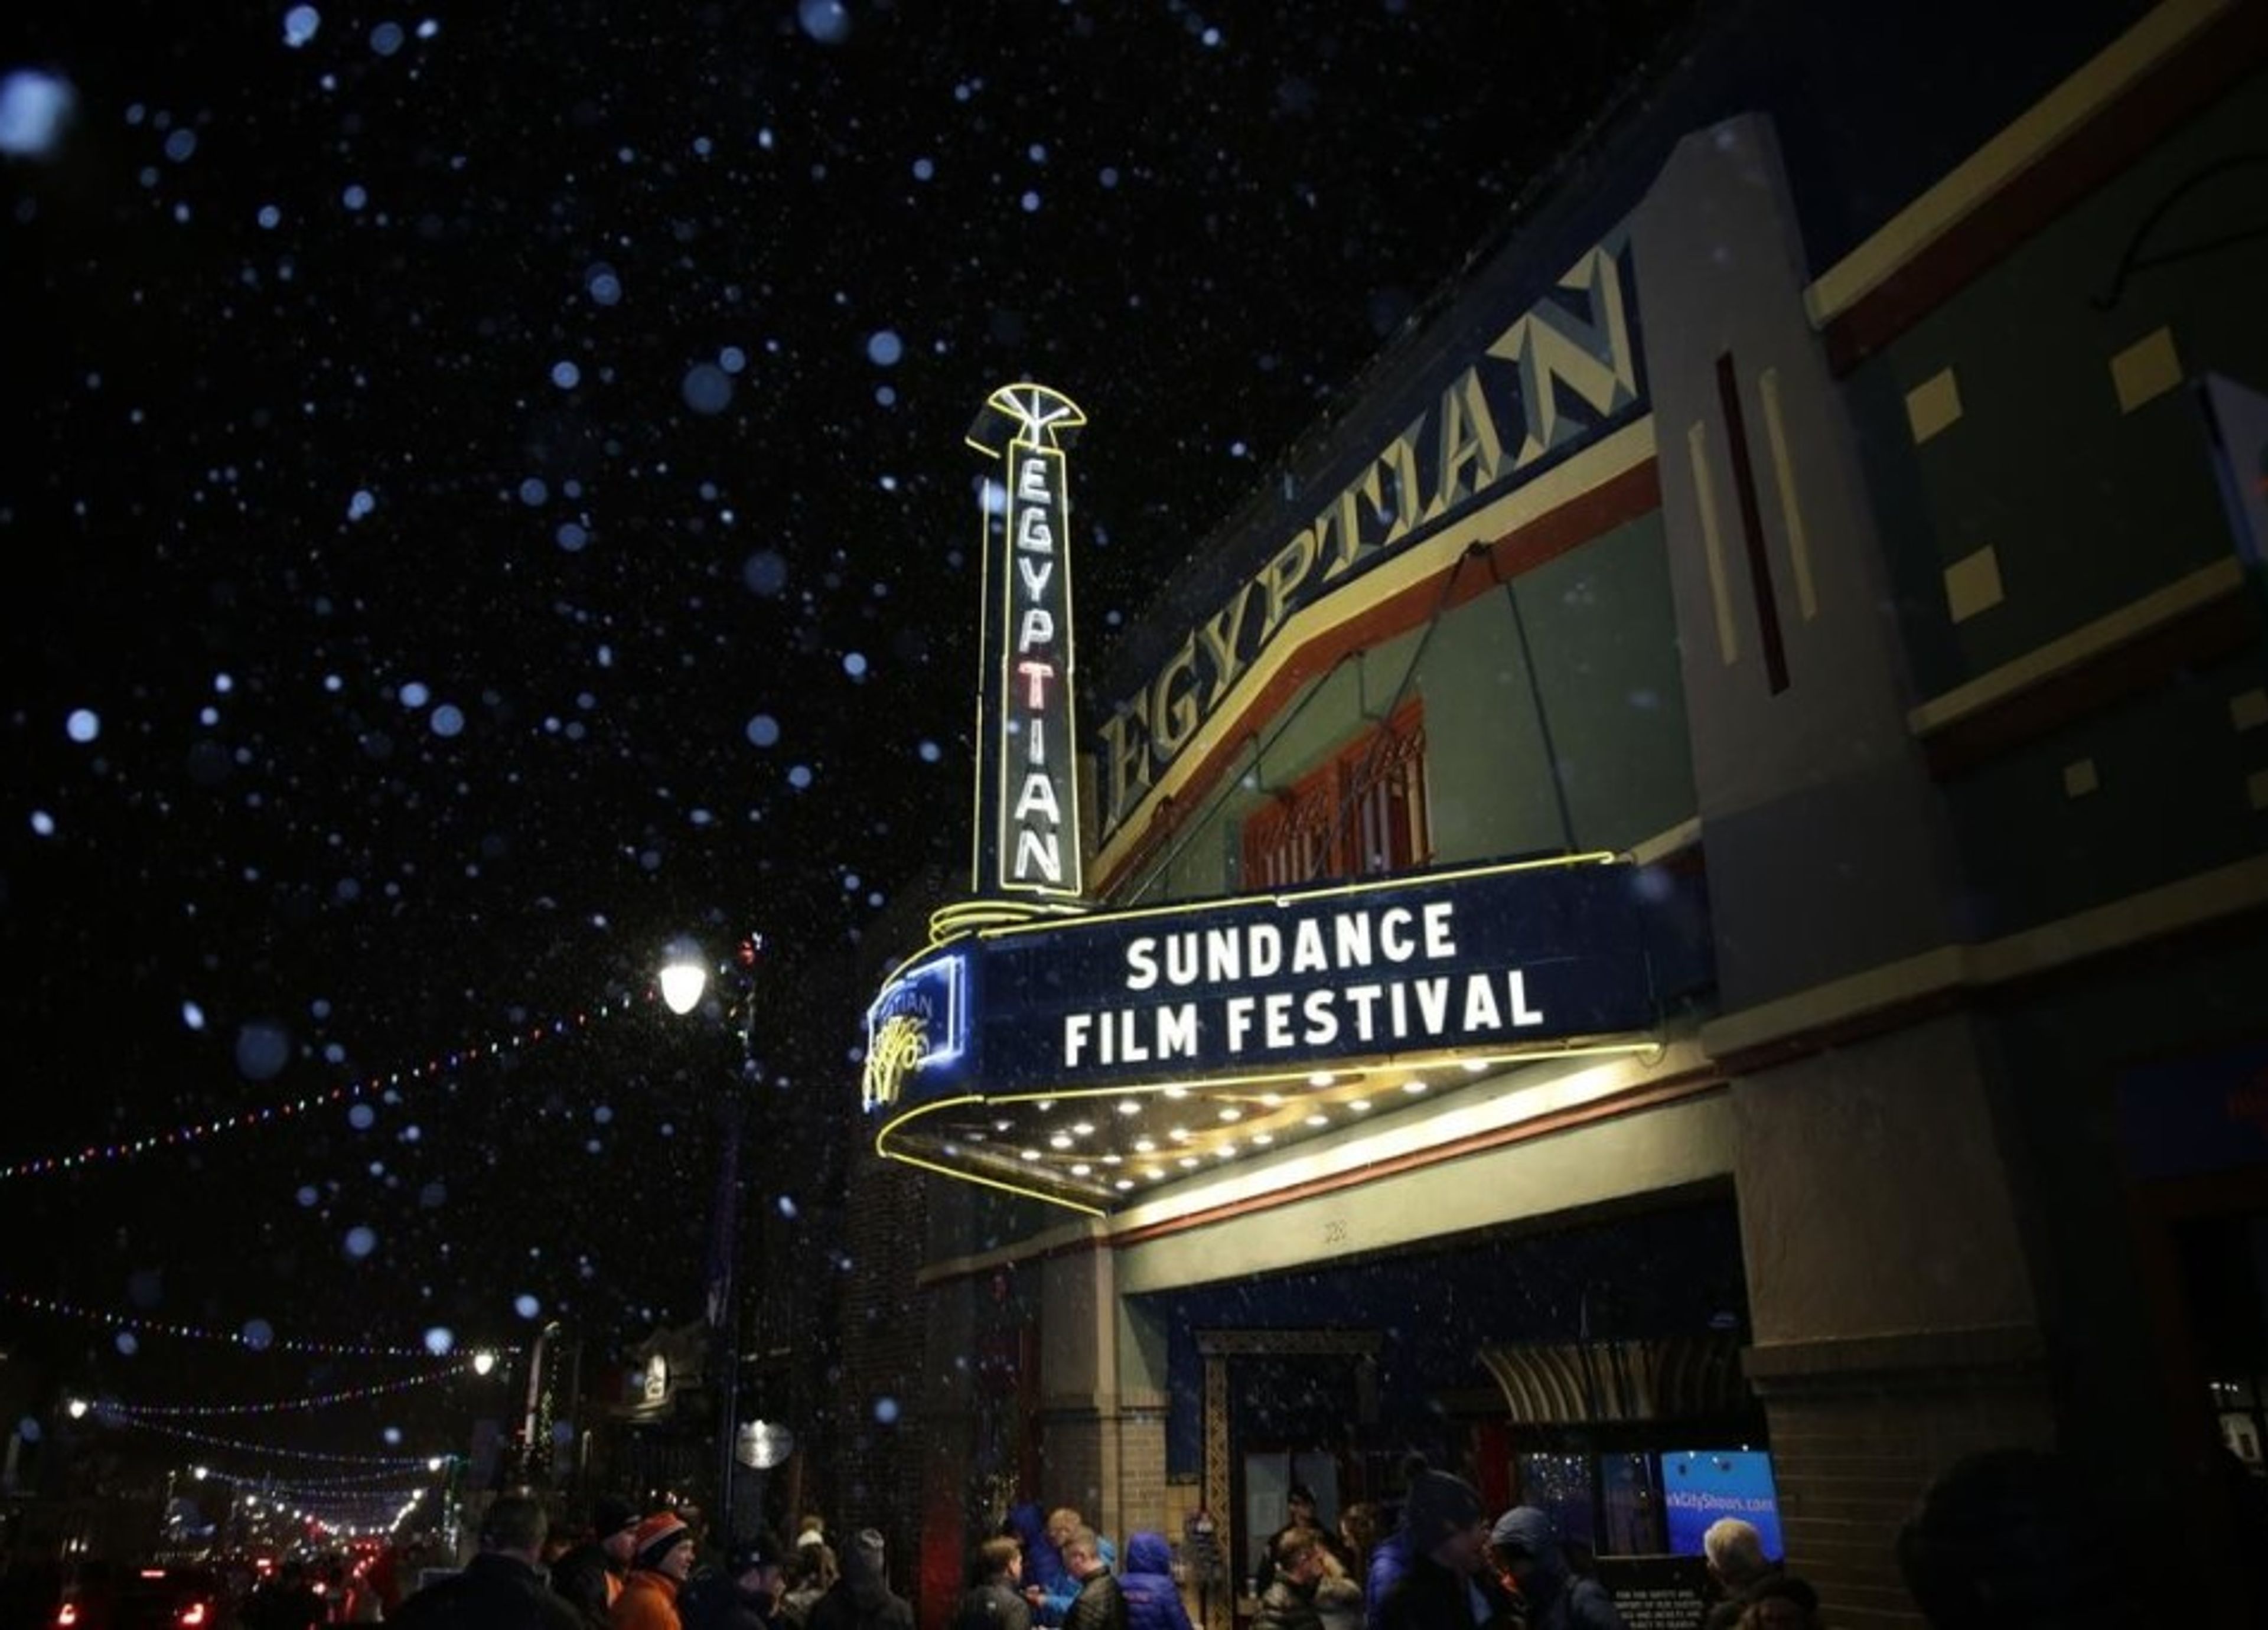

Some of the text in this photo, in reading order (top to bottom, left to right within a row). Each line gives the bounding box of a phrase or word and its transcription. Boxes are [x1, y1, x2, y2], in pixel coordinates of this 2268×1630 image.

[1099, 236, 1640, 840] EGYPTIAN
[1014, 458, 1061, 882] EGYPTIAN
[1064, 969, 1544, 1067] FILM FESTIVAL
[1125, 901, 1457, 992] SUNDANCE
